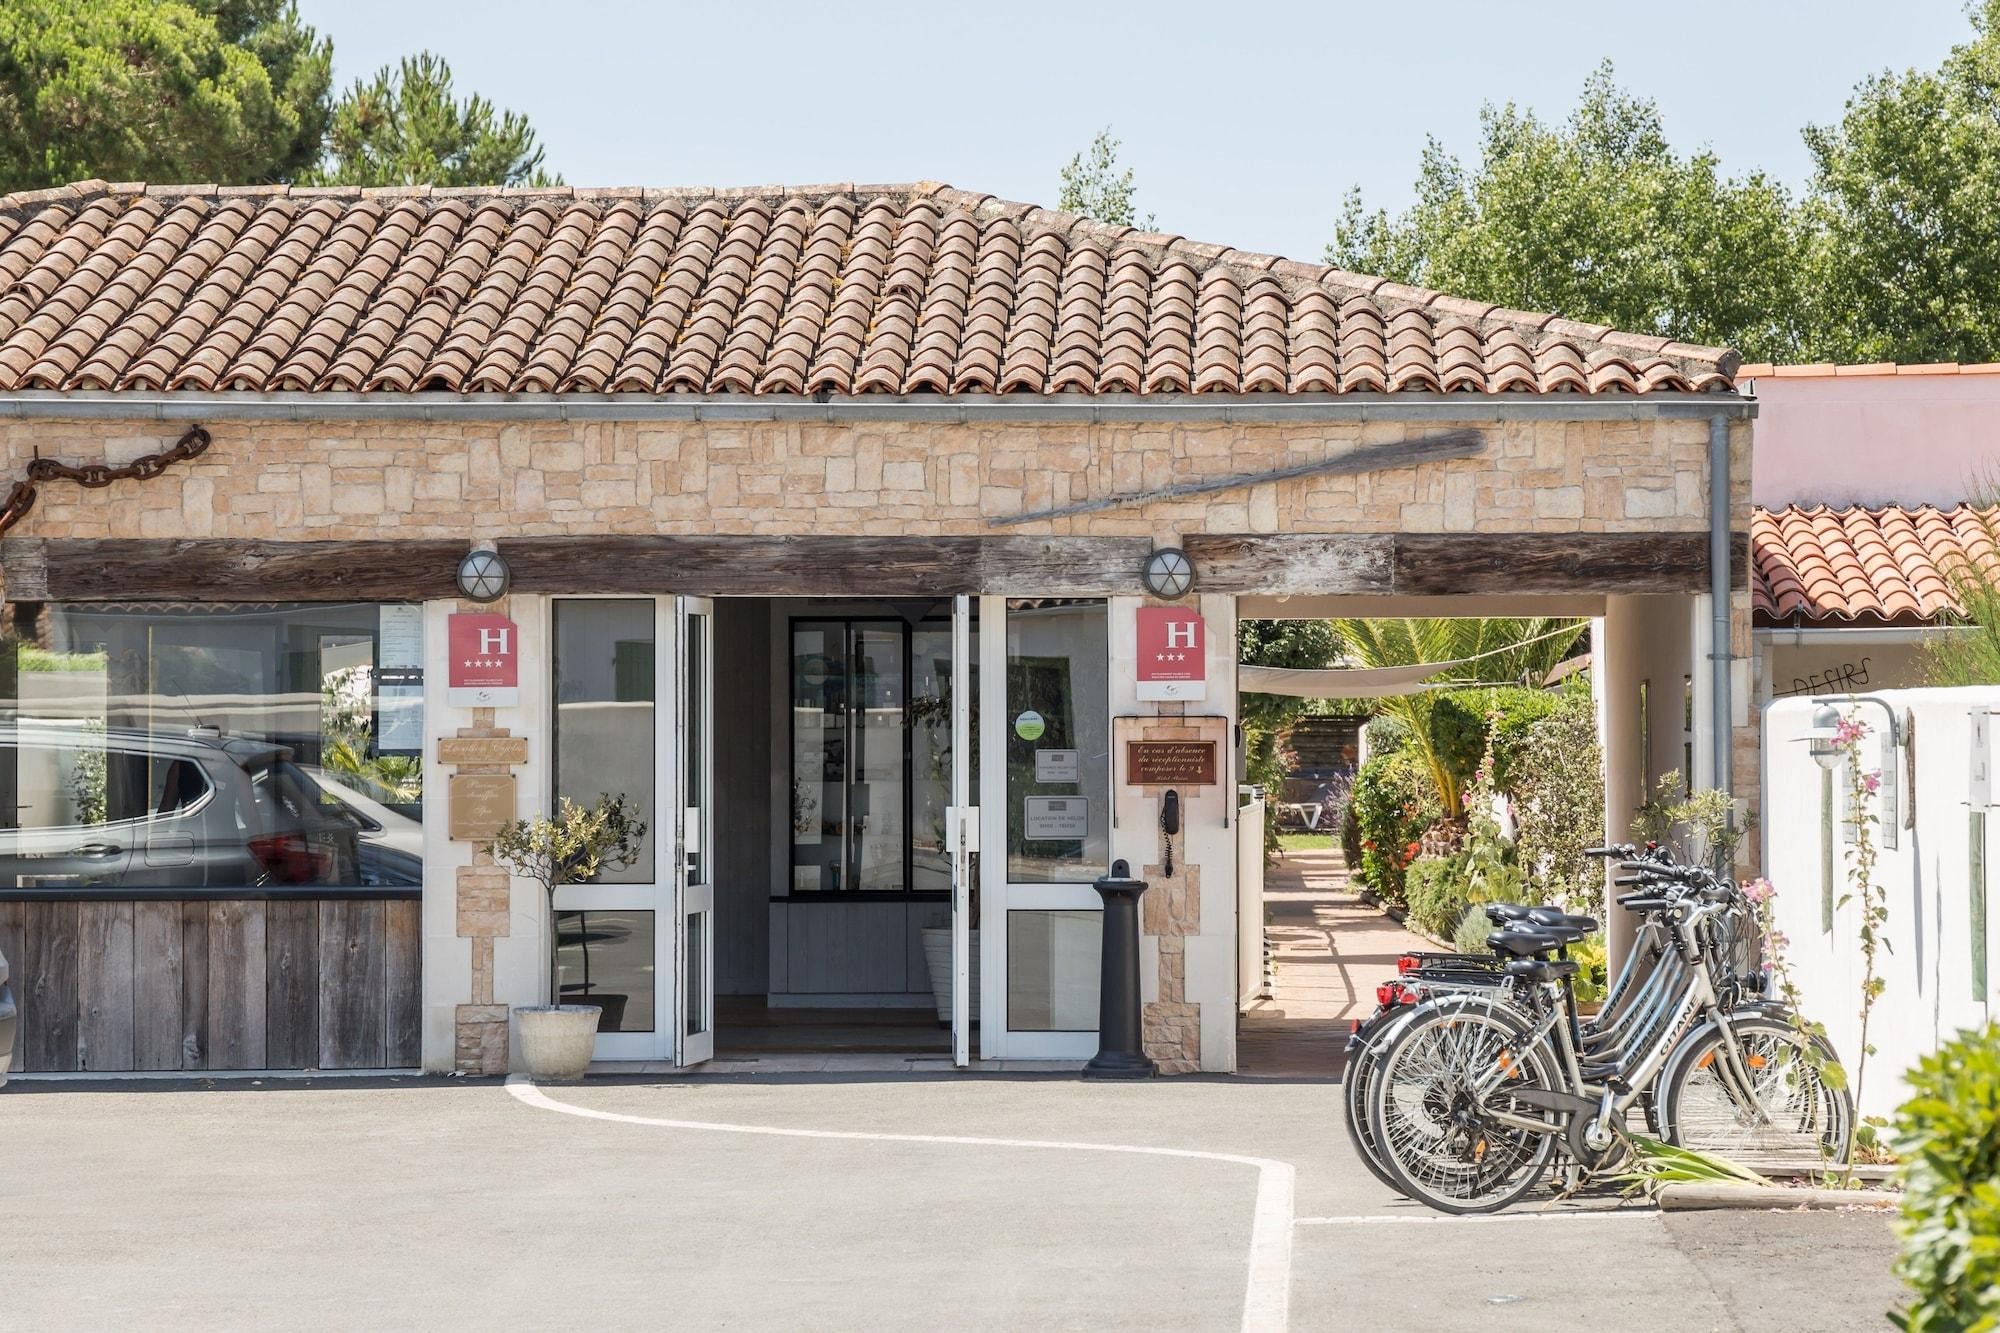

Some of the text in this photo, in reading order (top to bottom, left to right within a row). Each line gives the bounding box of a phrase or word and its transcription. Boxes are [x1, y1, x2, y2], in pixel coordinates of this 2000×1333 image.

[477, 628, 511, 655] H
[1165, 621, 1198, 648] H
[1137, 745, 1149, 754] En
[1167, 745, 1206, 754] d'absence
[1138, 755, 1149, 763] du
[1140, 765, 1177, 775] composer
[1179, 764, 1187, 772] le
[1603, 973, 1631, 1020] GITANE
[1660, 993, 1699, 1057] GITANE
